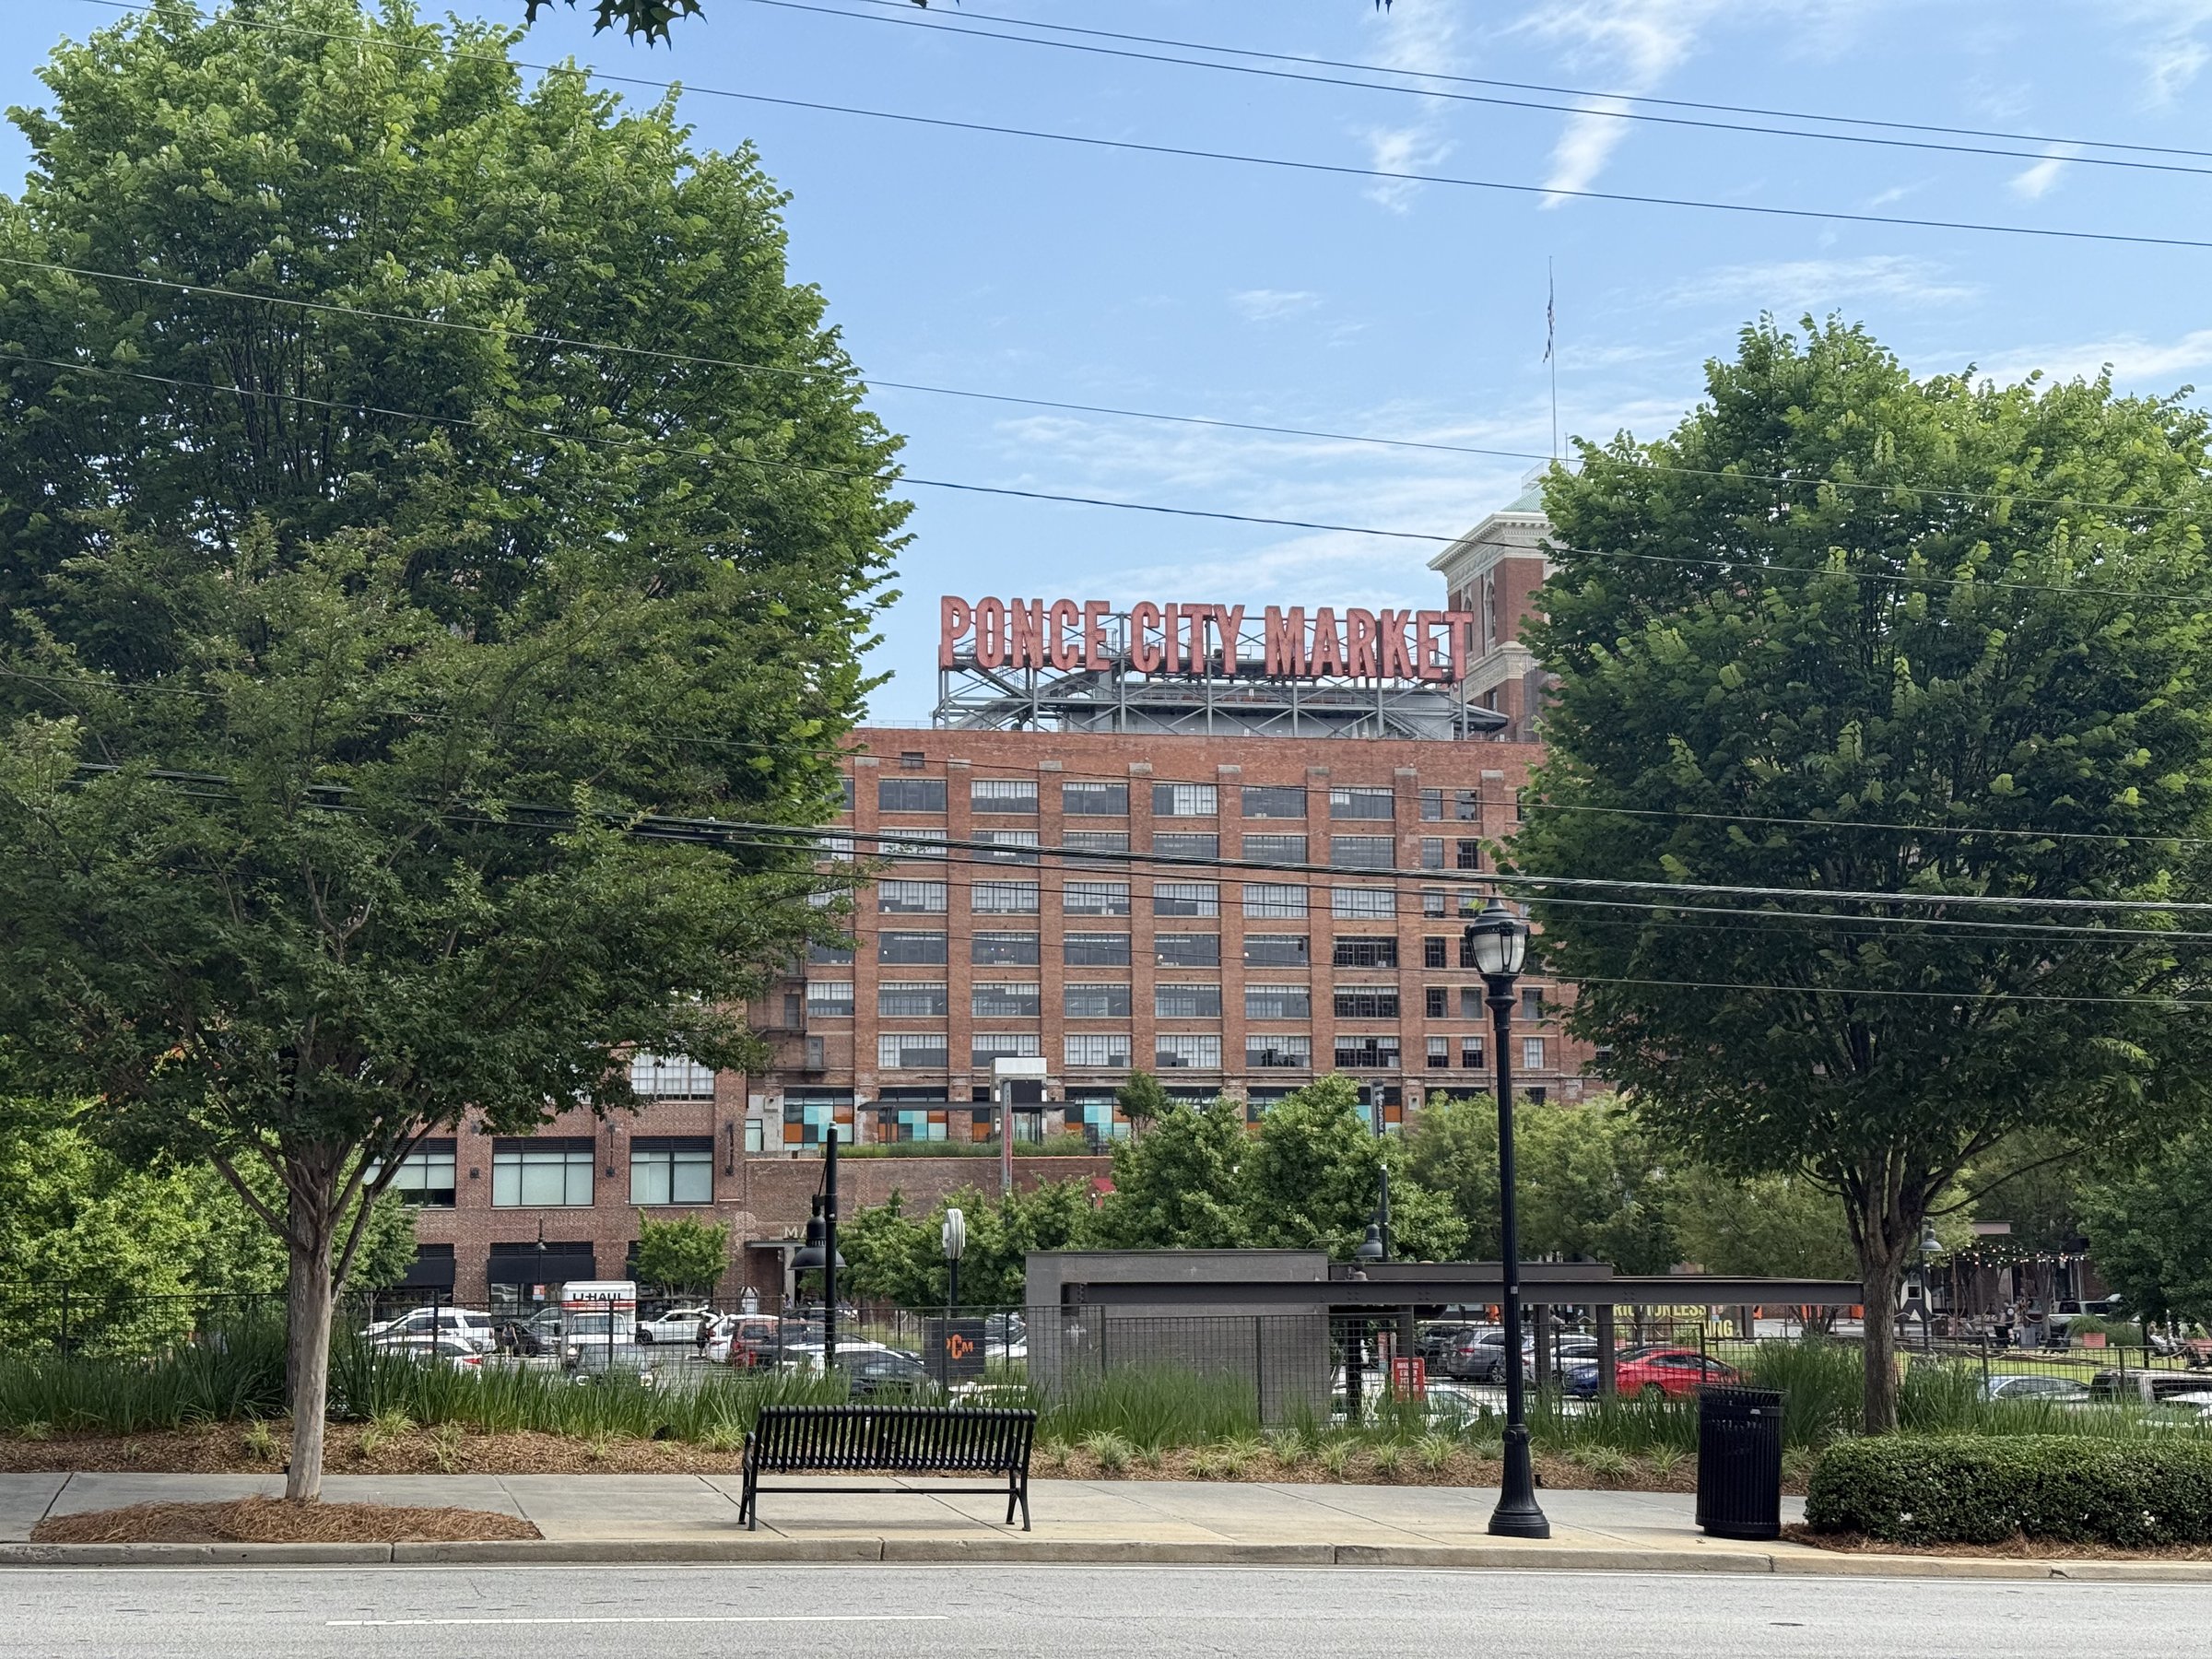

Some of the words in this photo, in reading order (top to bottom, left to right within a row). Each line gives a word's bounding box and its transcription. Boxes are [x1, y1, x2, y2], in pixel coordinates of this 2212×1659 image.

[941, 595, 1112, 671] PONCE
[1130, 600, 1246, 674] CITY
[1265, 605, 1475, 681] MARKET
[572, 1292, 623, 1301] U-HAUL
